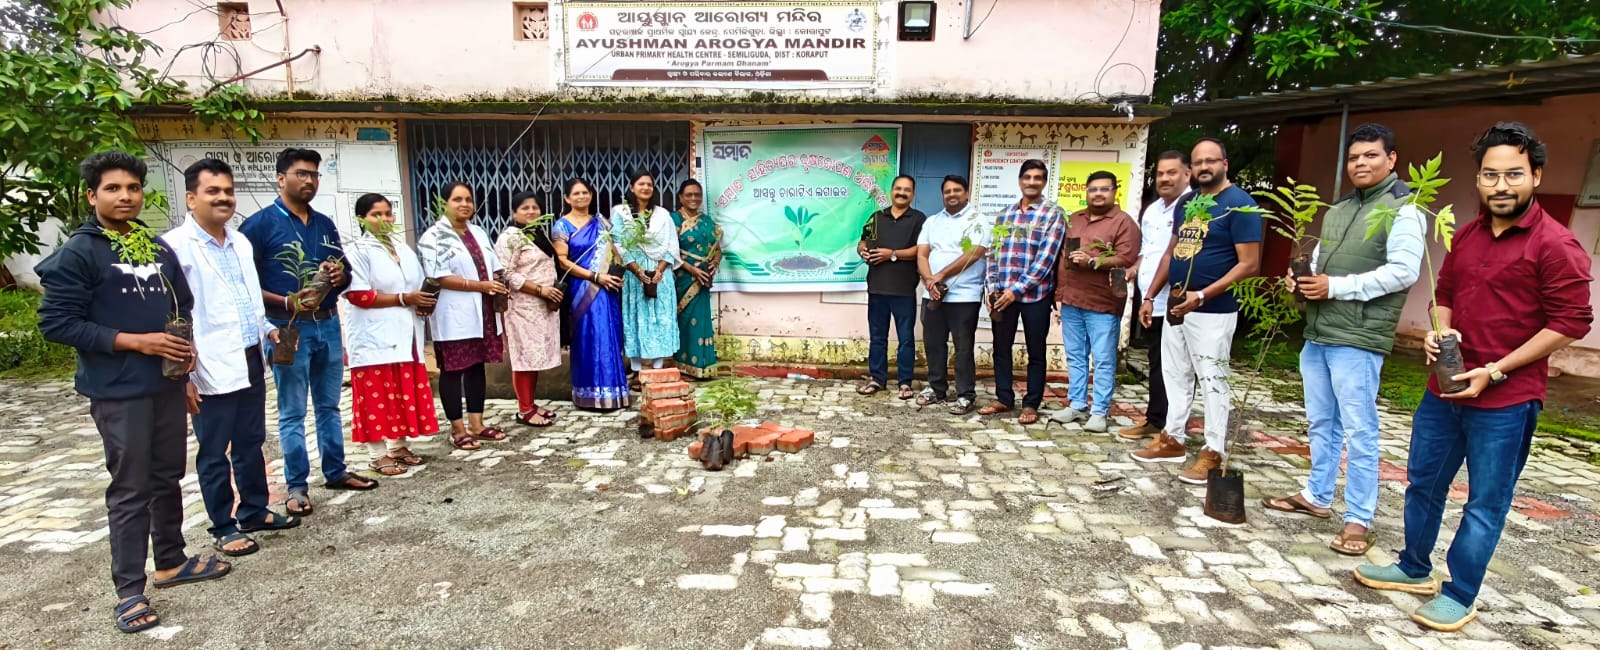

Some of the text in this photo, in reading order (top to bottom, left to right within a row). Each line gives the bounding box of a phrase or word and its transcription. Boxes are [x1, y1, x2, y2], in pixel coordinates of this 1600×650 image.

[694, 11, 768, 23] ଆରୋଗ୍ୟ
[776, 8, 822, 23] ମନ୍ଦିର
[576, 38, 866, 49] AYUSHMAN AROGYA MANDIR
[611, 50, 634, 58] URBAN
[636, 50, 665, 58] PRIMARY
[667, 50, 693, 58] HEALTH
[695, 50, 722, 58] CENTRE
[727, 50, 771, 59] SEMILIGUDA,
[774, 50, 790, 58] DIST
[796, 50, 828, 58] KORAPUT
